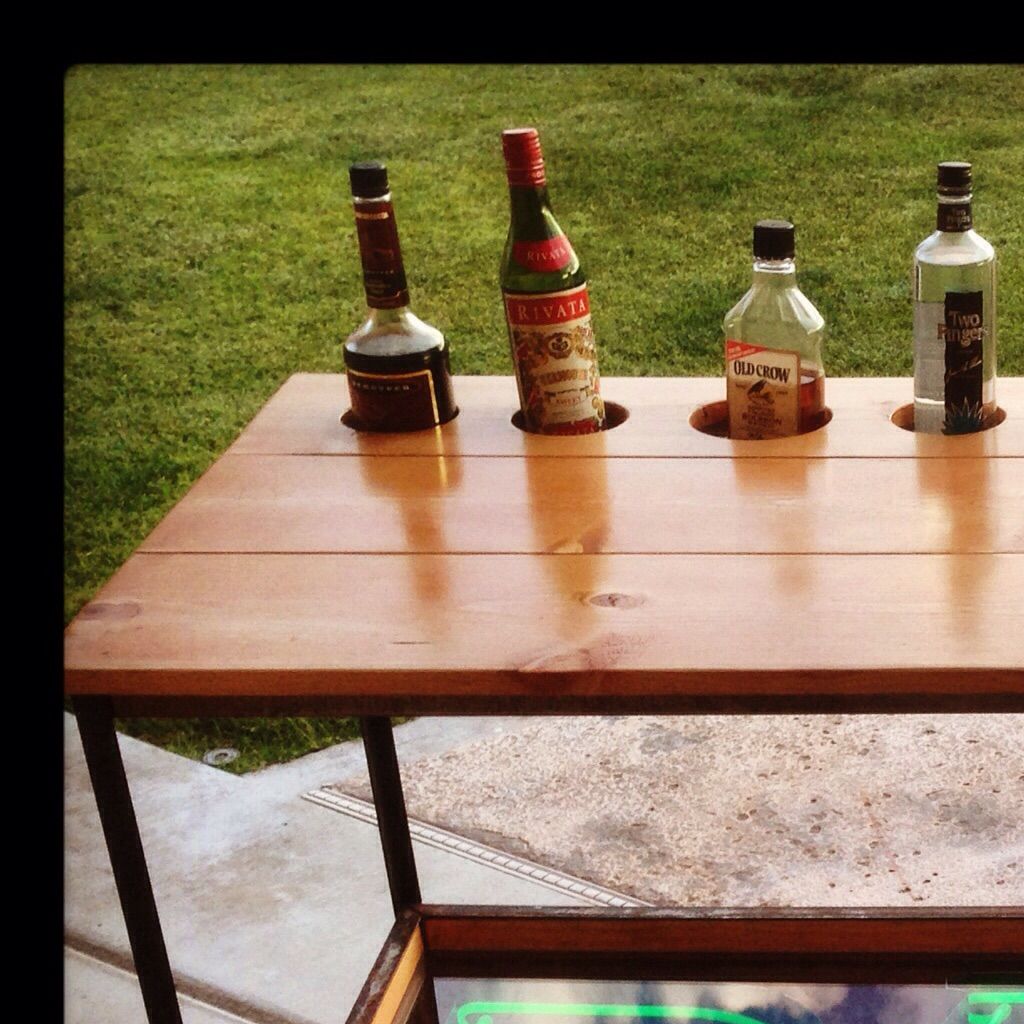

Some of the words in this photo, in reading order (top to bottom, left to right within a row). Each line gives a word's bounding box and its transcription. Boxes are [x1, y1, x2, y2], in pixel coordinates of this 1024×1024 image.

[527, 246, 567, 261] RIVATA
[517, 298, 587, 321] RIVATA
[949, 311, 980, 328] Two
[733, 359, 755, 376] OLD
[755, 363, 791, 384] CROW
